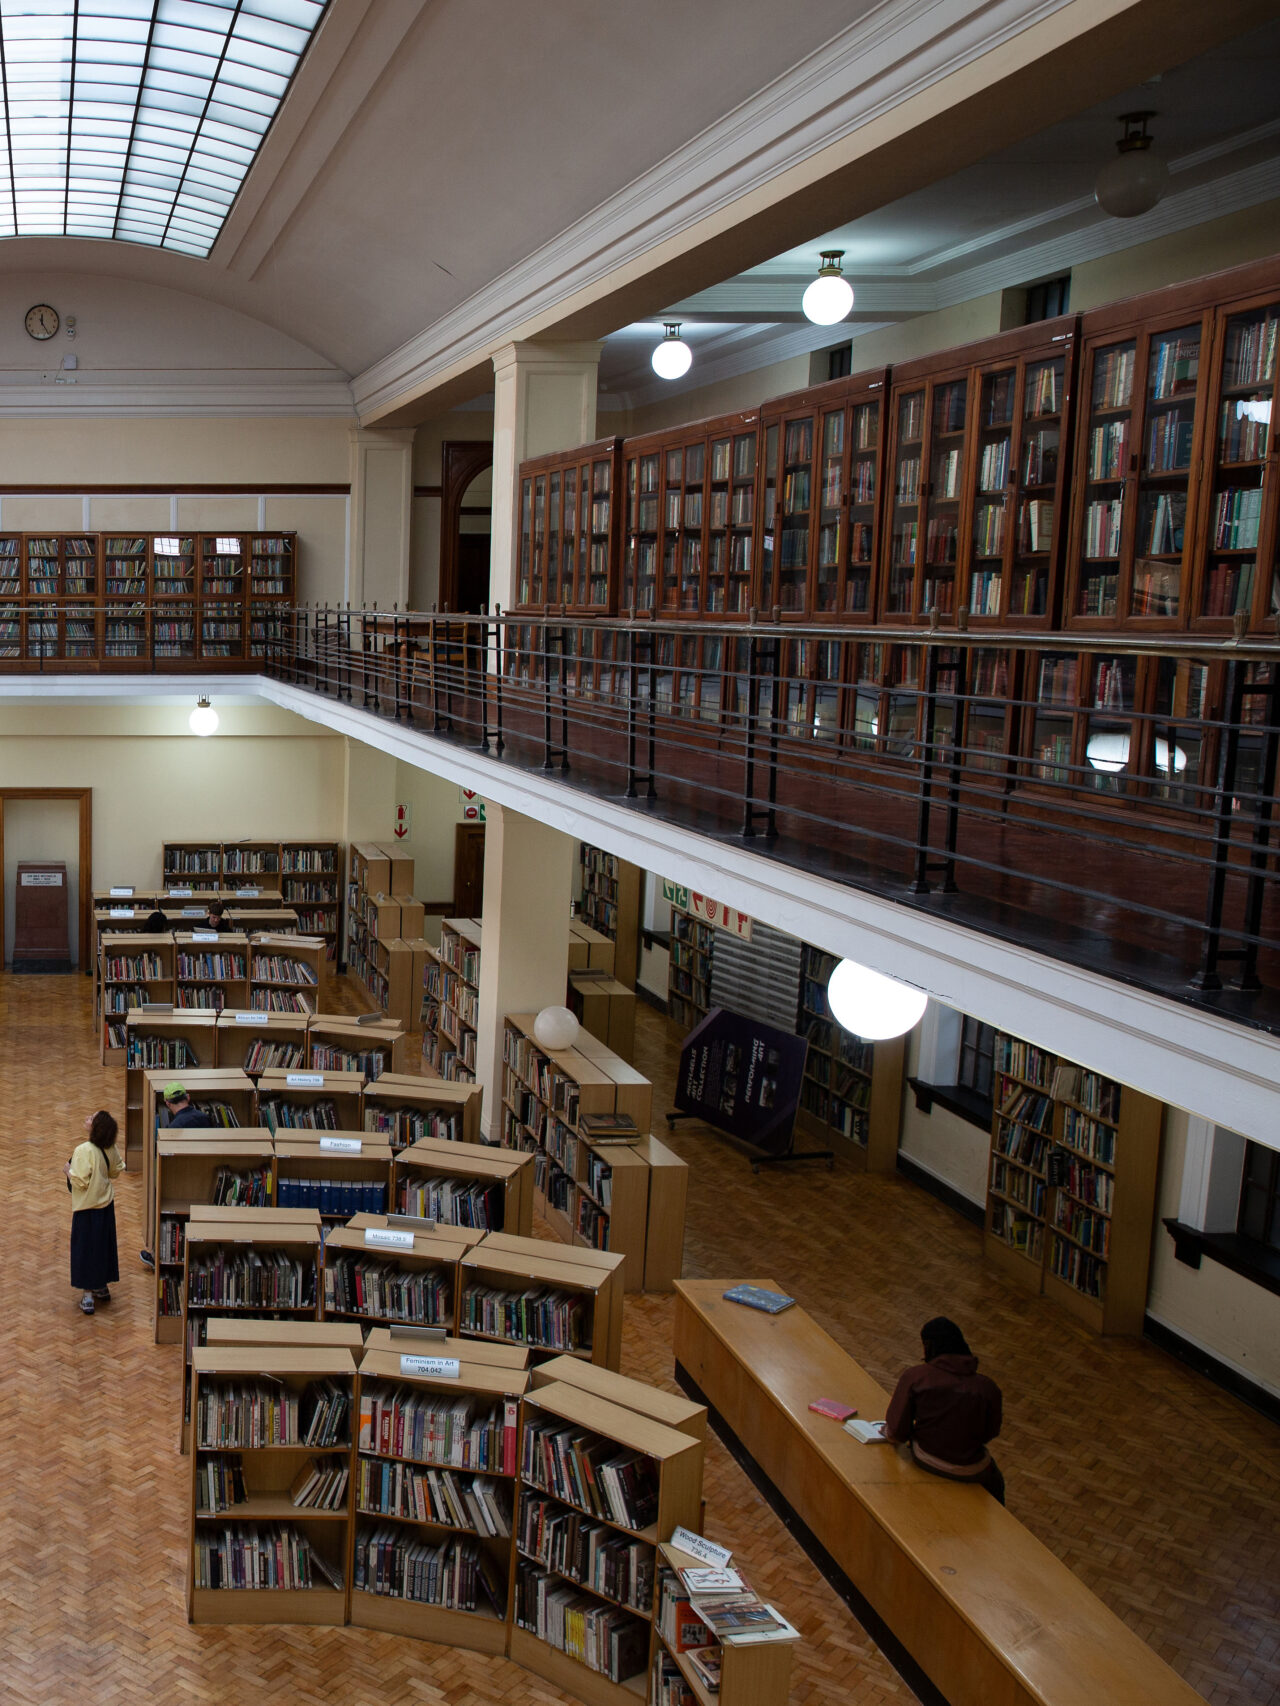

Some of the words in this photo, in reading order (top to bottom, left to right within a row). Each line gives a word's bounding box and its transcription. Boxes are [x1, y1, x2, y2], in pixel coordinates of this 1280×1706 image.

[758, 1040, 766, 1062] ART
[686, 1047, 697, 1097] MICHAELIS
[696, 1046, 709, 1101] COLLECTION
[744, 1038, 760, 1103] PERFORMING
[691, 1079, 699, 1099] ART
[406, 1358, 436, 1366] Feminism
[679, 1530, 697, 1545] Wood
[697, 1538, 727, 1559] Sculpture
